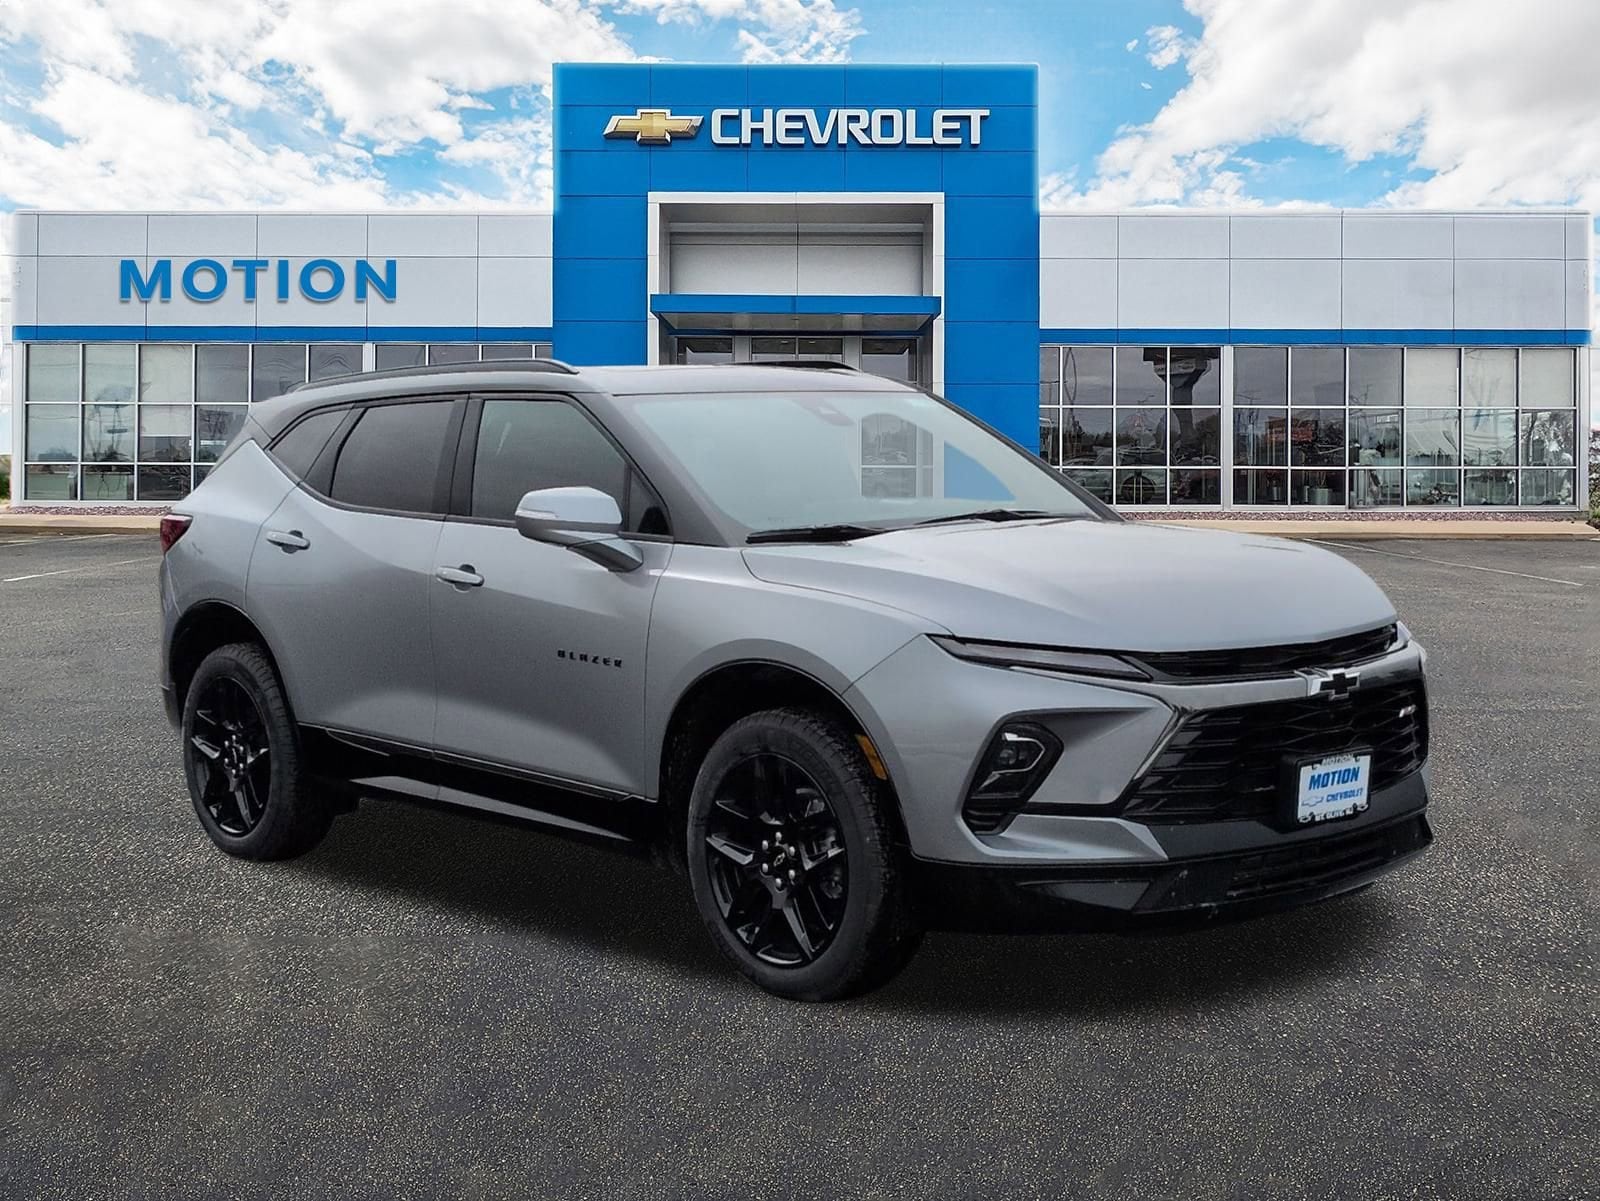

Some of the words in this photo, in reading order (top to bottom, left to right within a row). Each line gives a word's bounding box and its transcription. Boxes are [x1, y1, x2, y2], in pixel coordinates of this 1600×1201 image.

[711, 108, 990, 145] CHEVROLET
[119, 257, 397, 303] MOTION
[557, 650, 622, 668] BLAZER
[1308, 766, 1361, 791] MOTION
